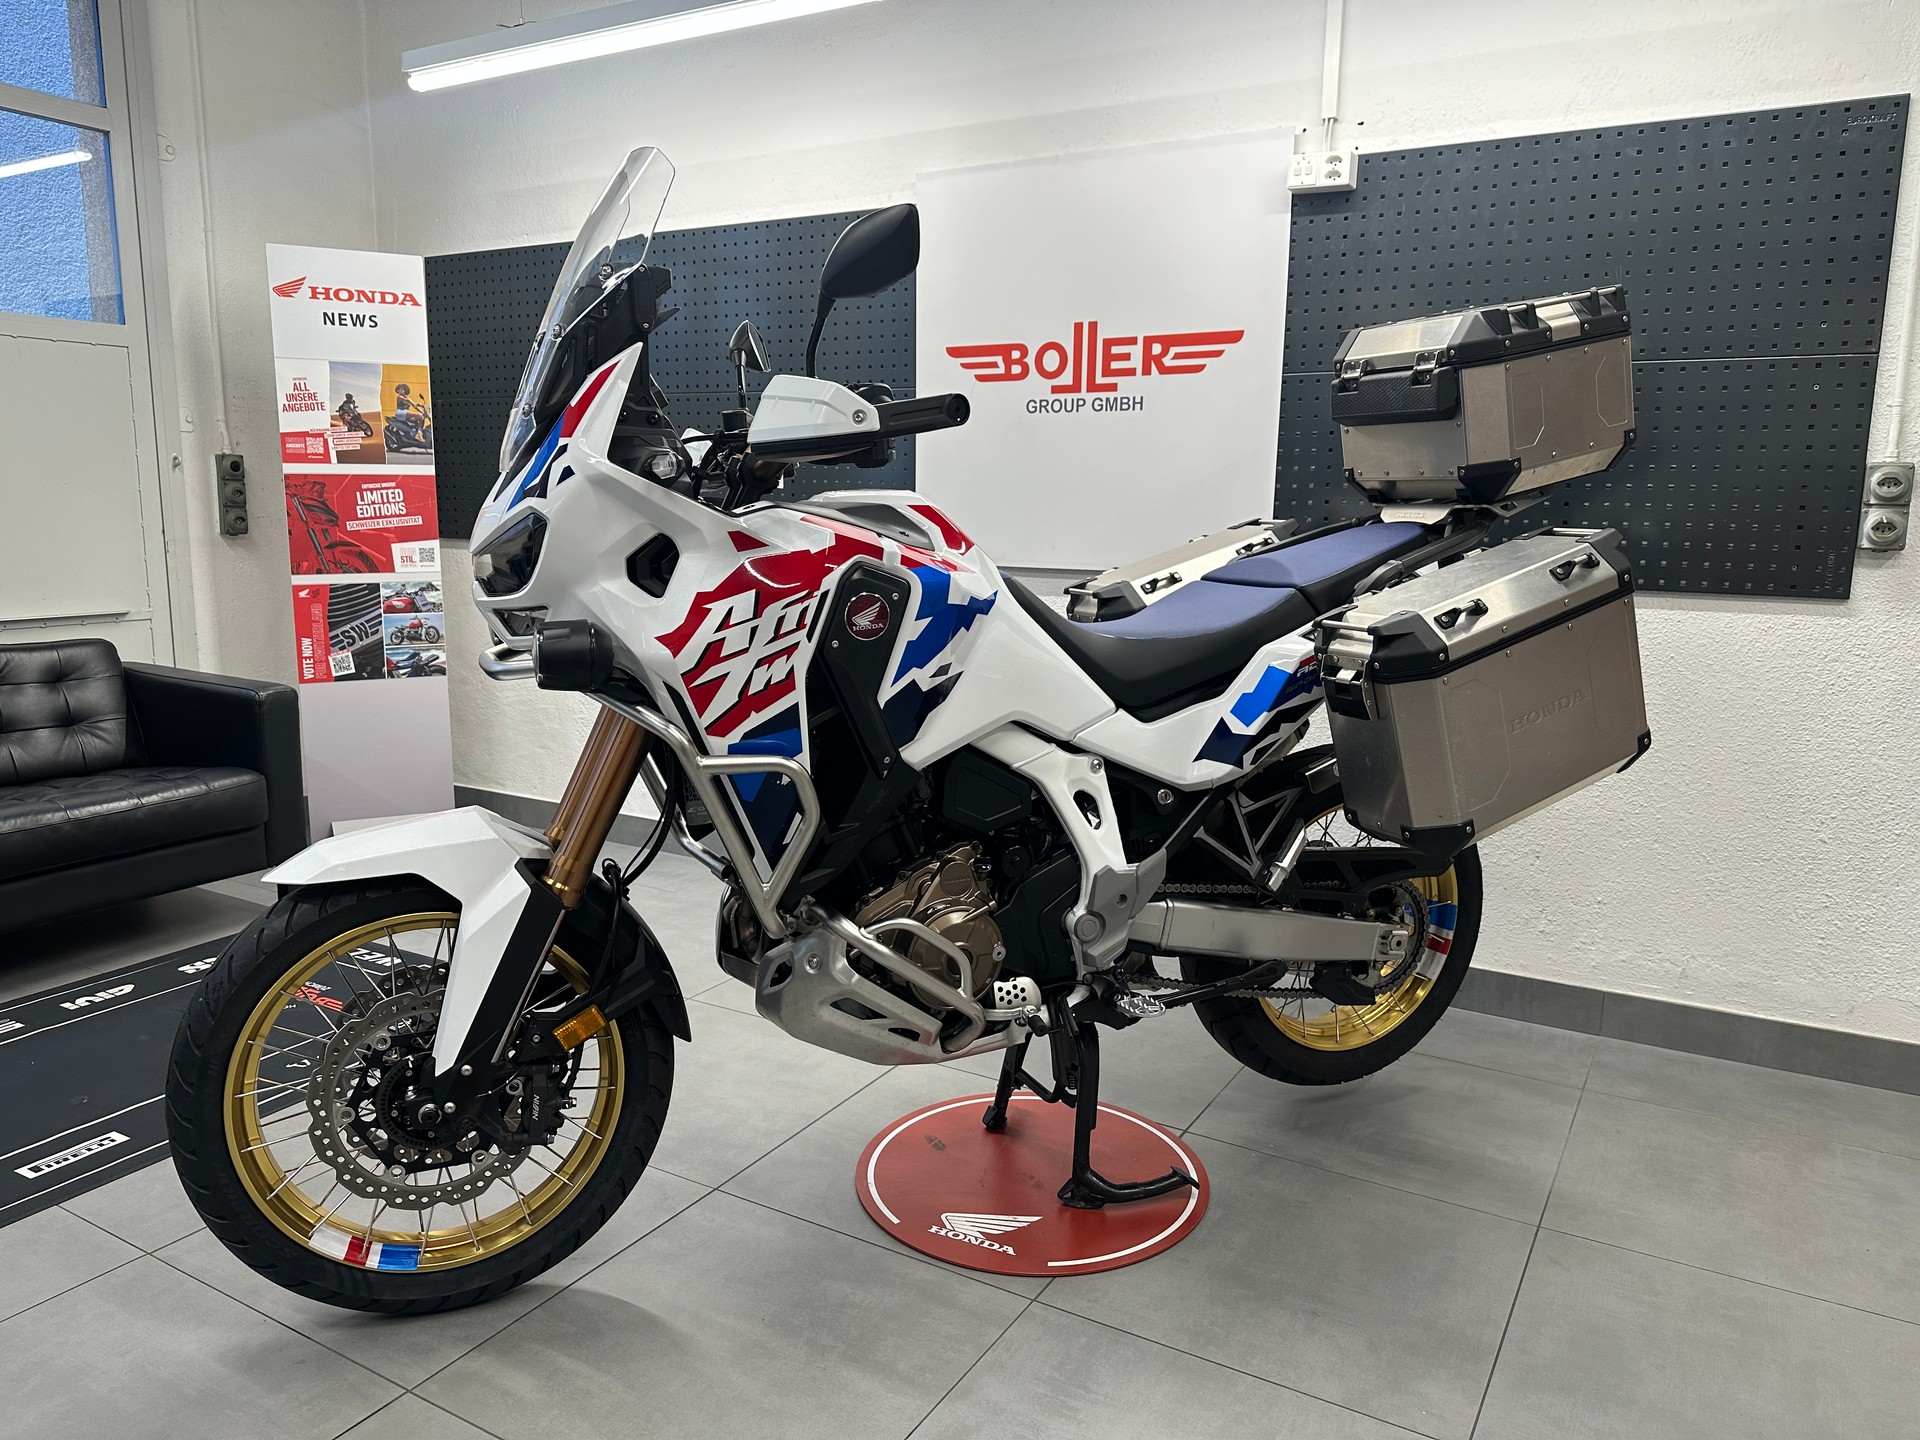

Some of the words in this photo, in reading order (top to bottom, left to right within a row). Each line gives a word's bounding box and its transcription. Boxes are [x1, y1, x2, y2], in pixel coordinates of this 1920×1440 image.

[307, 285, 422, 307] HONDA
[323, 311, 379, 328] NEWS
[946, 321, 1245, 394] BOLLER
[292, 381, 311, 392] ALL
[286, 392, 319, 403] UNSERE
[1026, 397, 1087, 414] GROUP
[1091, 395, 1144, 412] GMBH
[282, 402, 326, 413] ANGEBOTE
[356, 489, 404, 505] LIMITED
[356, 502, 407, 518] EDITIONS
[348, 520, 381, 530] SCHWEIZER
[852, 623, 884, 631] HONDA
[300, 637, 313, 657] NOW
[303, 658, 315, 680] VOTE
[314, 661, 327, 679] FOR
[1511, 688, 1591, 735] HONDA
[59, 983, 137, 1011] GIVI
[27, 1136, 118, 1174] PIRELLI
[927, 1224, 1017, 1256] HONDA
